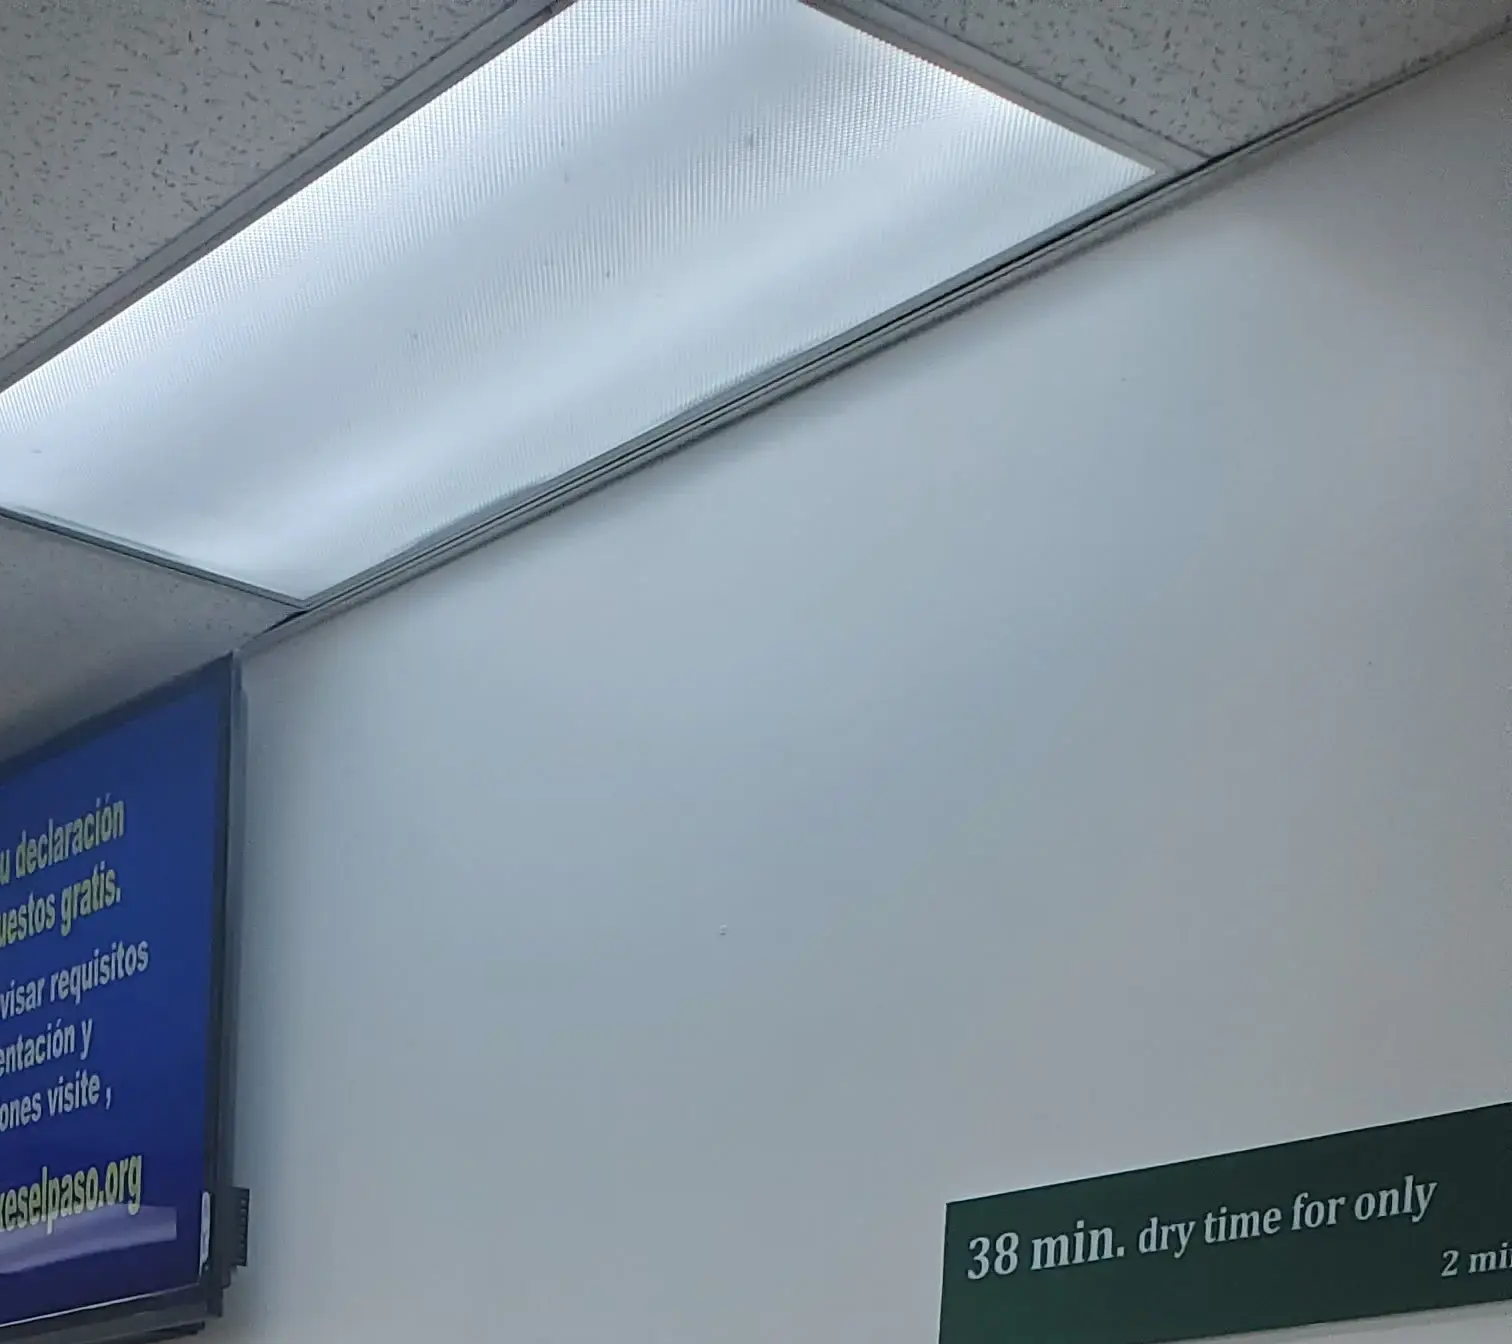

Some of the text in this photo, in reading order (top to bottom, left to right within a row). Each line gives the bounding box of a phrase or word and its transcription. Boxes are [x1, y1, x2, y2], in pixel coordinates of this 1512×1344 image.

[15, 793, 125, 878] declaración
[60, 861, 121, 937] gratis.
[50, 940, 149, 1005] requisitos
[80, 1018, 93, 1060] y
[967, 1175, 1438, 1280] 38 min. dry time for only
[1441, 1242, 1512, 1277] 2 mi
